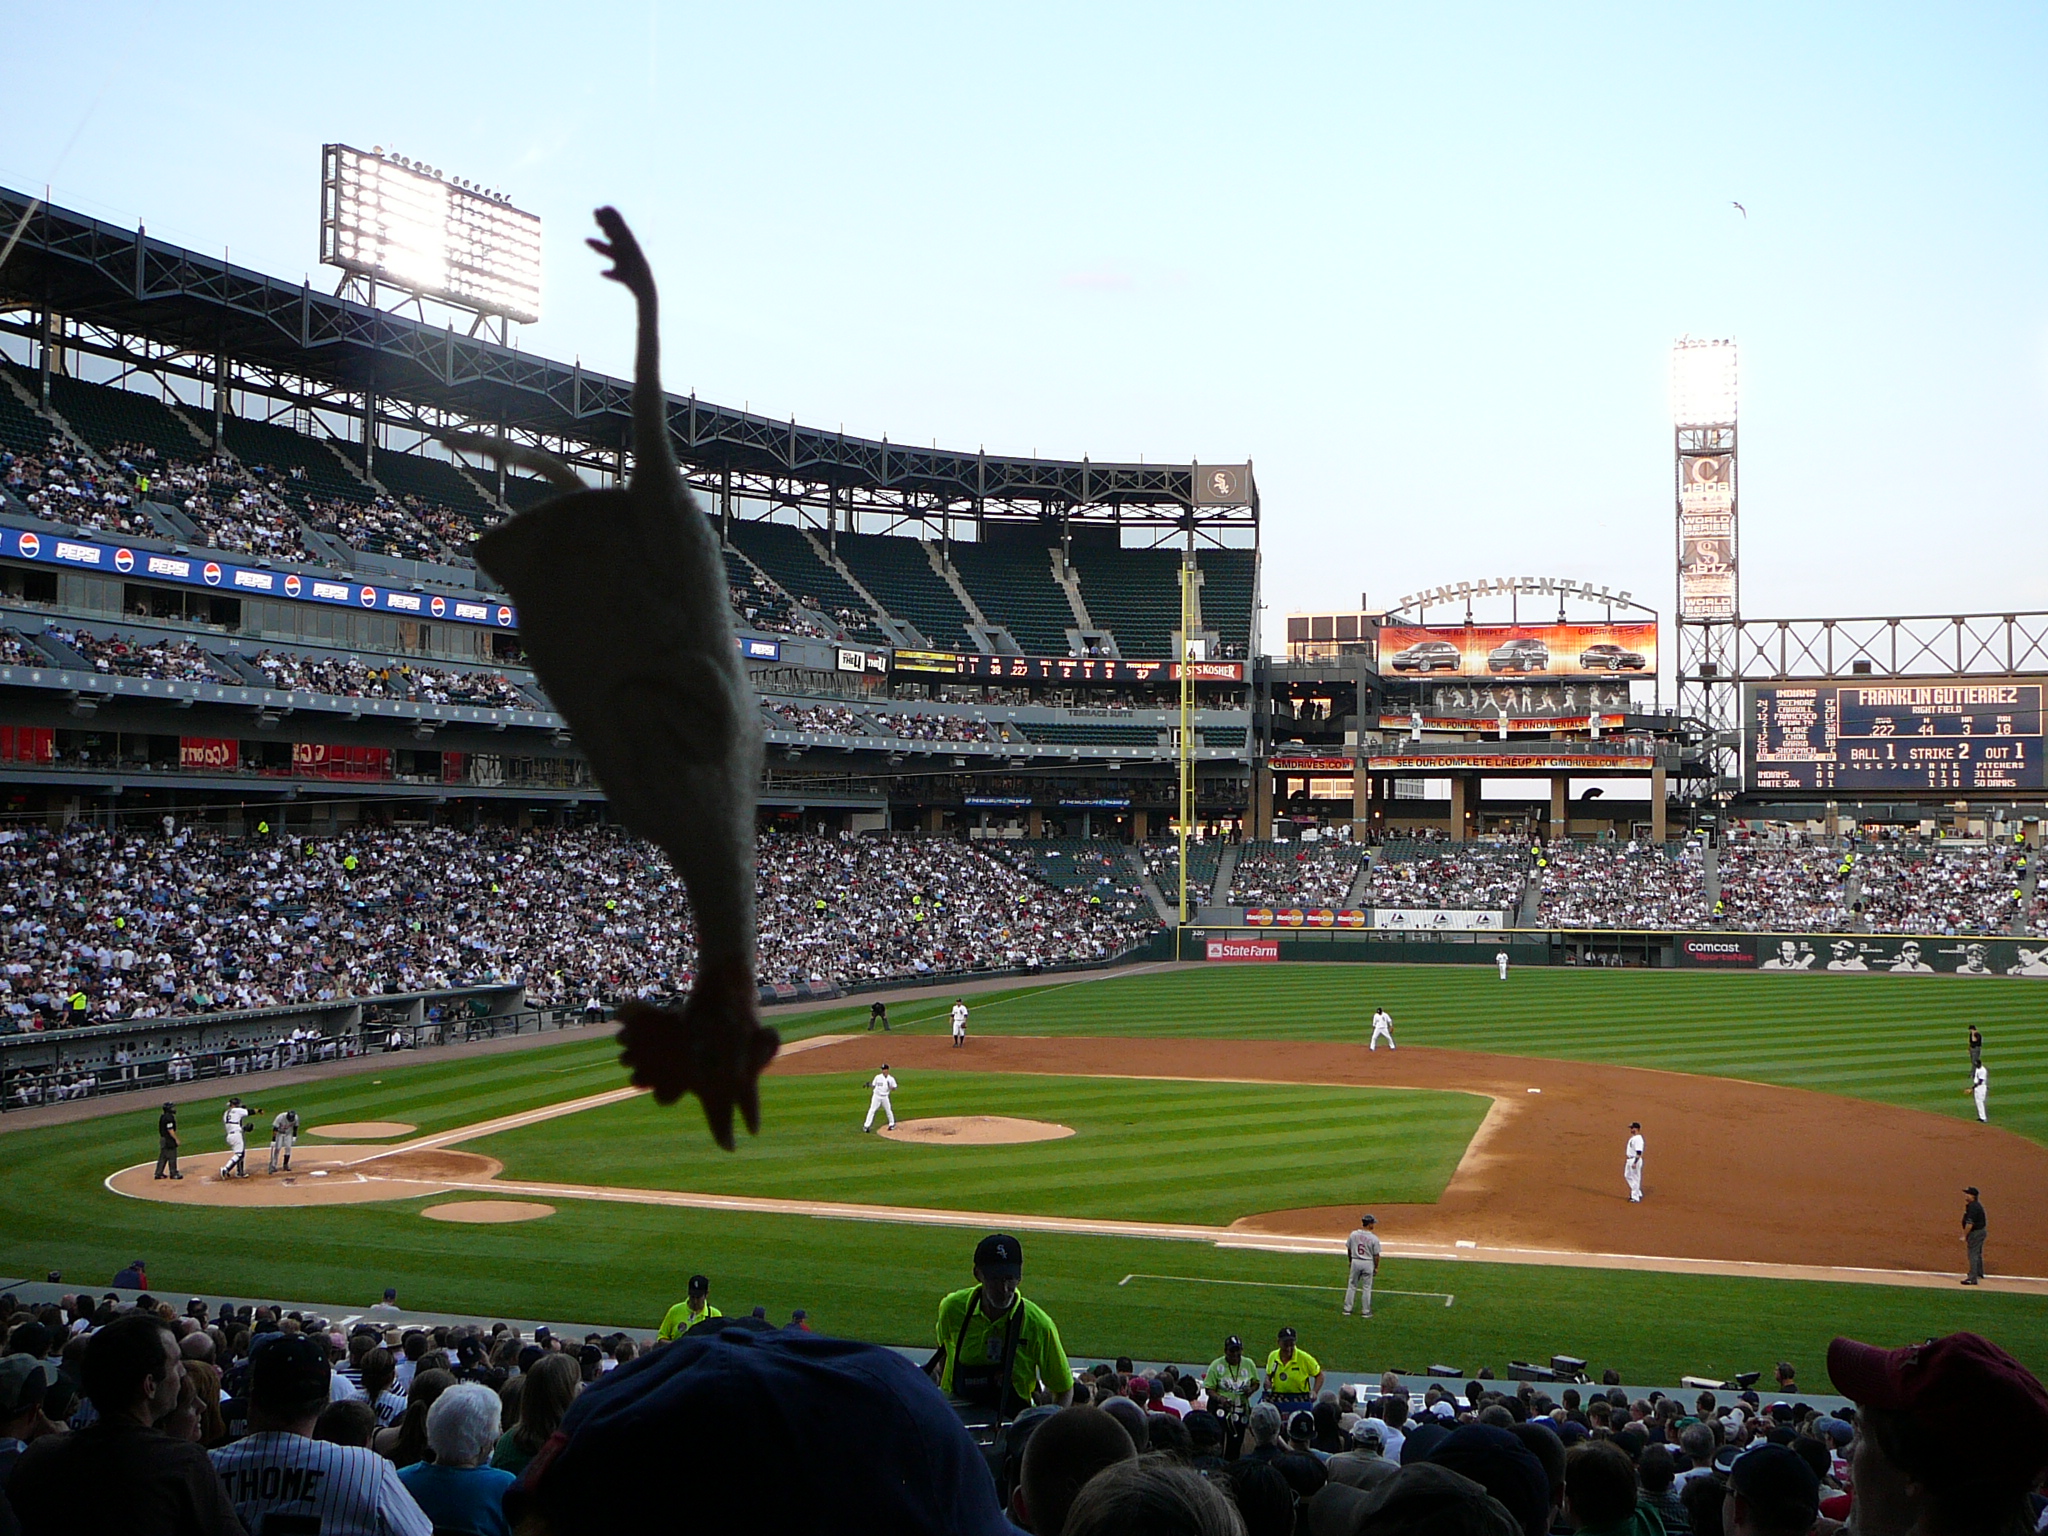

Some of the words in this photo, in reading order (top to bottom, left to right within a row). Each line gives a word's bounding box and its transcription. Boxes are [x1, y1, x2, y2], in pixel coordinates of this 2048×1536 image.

[1683, 482, 1730, 492] 1906
[1684, 516, 1730, 524] WORLD
[56, 542, 100, 563] PEPSI
[148, 557, 190, 577] PEPSI
[1689, 564, 1727, 573] 1917
[235, 570, 273, 589] PEPSI
[313, 582, 349, 600] PEPSI
[1400, 577, 1632, 615] FUNDAMENTALS
[388, 594, 421, 610] PEPSI
[1685, 598, 1730, 606] WORLD
[455, 603, 487, 620] PEPSI
[842, 655, 854, 664] THE
[867, 658, 878, 668] THE
[958, 663, 963, 673] 0
[970, 664, 975, 674] 1
[990, 665, 1001, 675] 38
[1010, 666, 1028, 676] .227
[1043, 667, 1048, 677] 1
[1063, 668, 1071, 678] 2
[1085, 668, 1091, 678] 1
[1106, 669, 1112, 679] 3
[1137, 669, 1149, 679] 37
[1176, 664, 1202, 678] BST'S
[1203, 664, 1235, 679] KOSHER
[1776, 689, 1817, 698] INDIANS
[1859, 689, 1931, 705] FRANKLIN
[1934, 687, 2017, 704] GUTIERREZ
[1776, 699, 1815, 707] SIZEMORE
[1068, 709, 1107, 717] TERRACE
[1109, 710, 1134, 718] SUITE
[1912, 706, 1936, 714] RIGHT
[1938, 705, 1962, 714] FIELD
[1423, 721, 1441, 729] UICK
[1517, 720, 1584, 729] FUNDAMENTALS
[1869, 725, 1895, 736] .227
[1918, 724, 1934, 736] 44
[1962, 724, 1971, 735] 3
[1995, 723, 2011, 735] 18
[1851, 748, 1880, 760] BALL
[1887, 743, 1895, 760] 1
[1910, 748, 1954, 760] STRIKE
[1959, 743, 1969, 759] 2
[1986, 747, 2009, 759] OUT
[2015, 742, 2024, 759] 1
[1273, 760, 1350, 769] GMDRIVES.COM
[1397, 759, 1413, 767] SEE
[1416, 758, 1436, 767] OUR
[1438, 758, 1494, 767] COMPLETE
[1495, 758, 1531, 767] LINEUP
[1536, 758, 1547, 766] AT
[1550, 758, 1618, 767] GMDRIVES.COM
[1757, 771, 1790, 779] INDIANS
[1928, 770, 1935, 778] 0
[1941, 770, 1947, 778] 1
[1953, 770, 1959, 778] 0
[1974, 770, 1985, 778] 31
[1987, 770, 2004, 778] LEE
[1783, 779, 1800, 787] SOX
[1816, 779, 1822, 787] 0
[1828, 779, 1834, 787] 1
[1928, 779, 1935, 787] 1
[1941, 779, 1947, 787] 3
[1953, 779, 1959, 787] 0
[1974, 779, 1985, 787] 50
[1223, 945, 1249, 956] State
[1250, 946, 1277, 956] Farm
[1688, 943, 1740, 952] comcast
[1358, 1244, 1365, 1255] 6
[376, 1403, 393, 1420] ND
[220, 1466, 325, 1501] THOME
